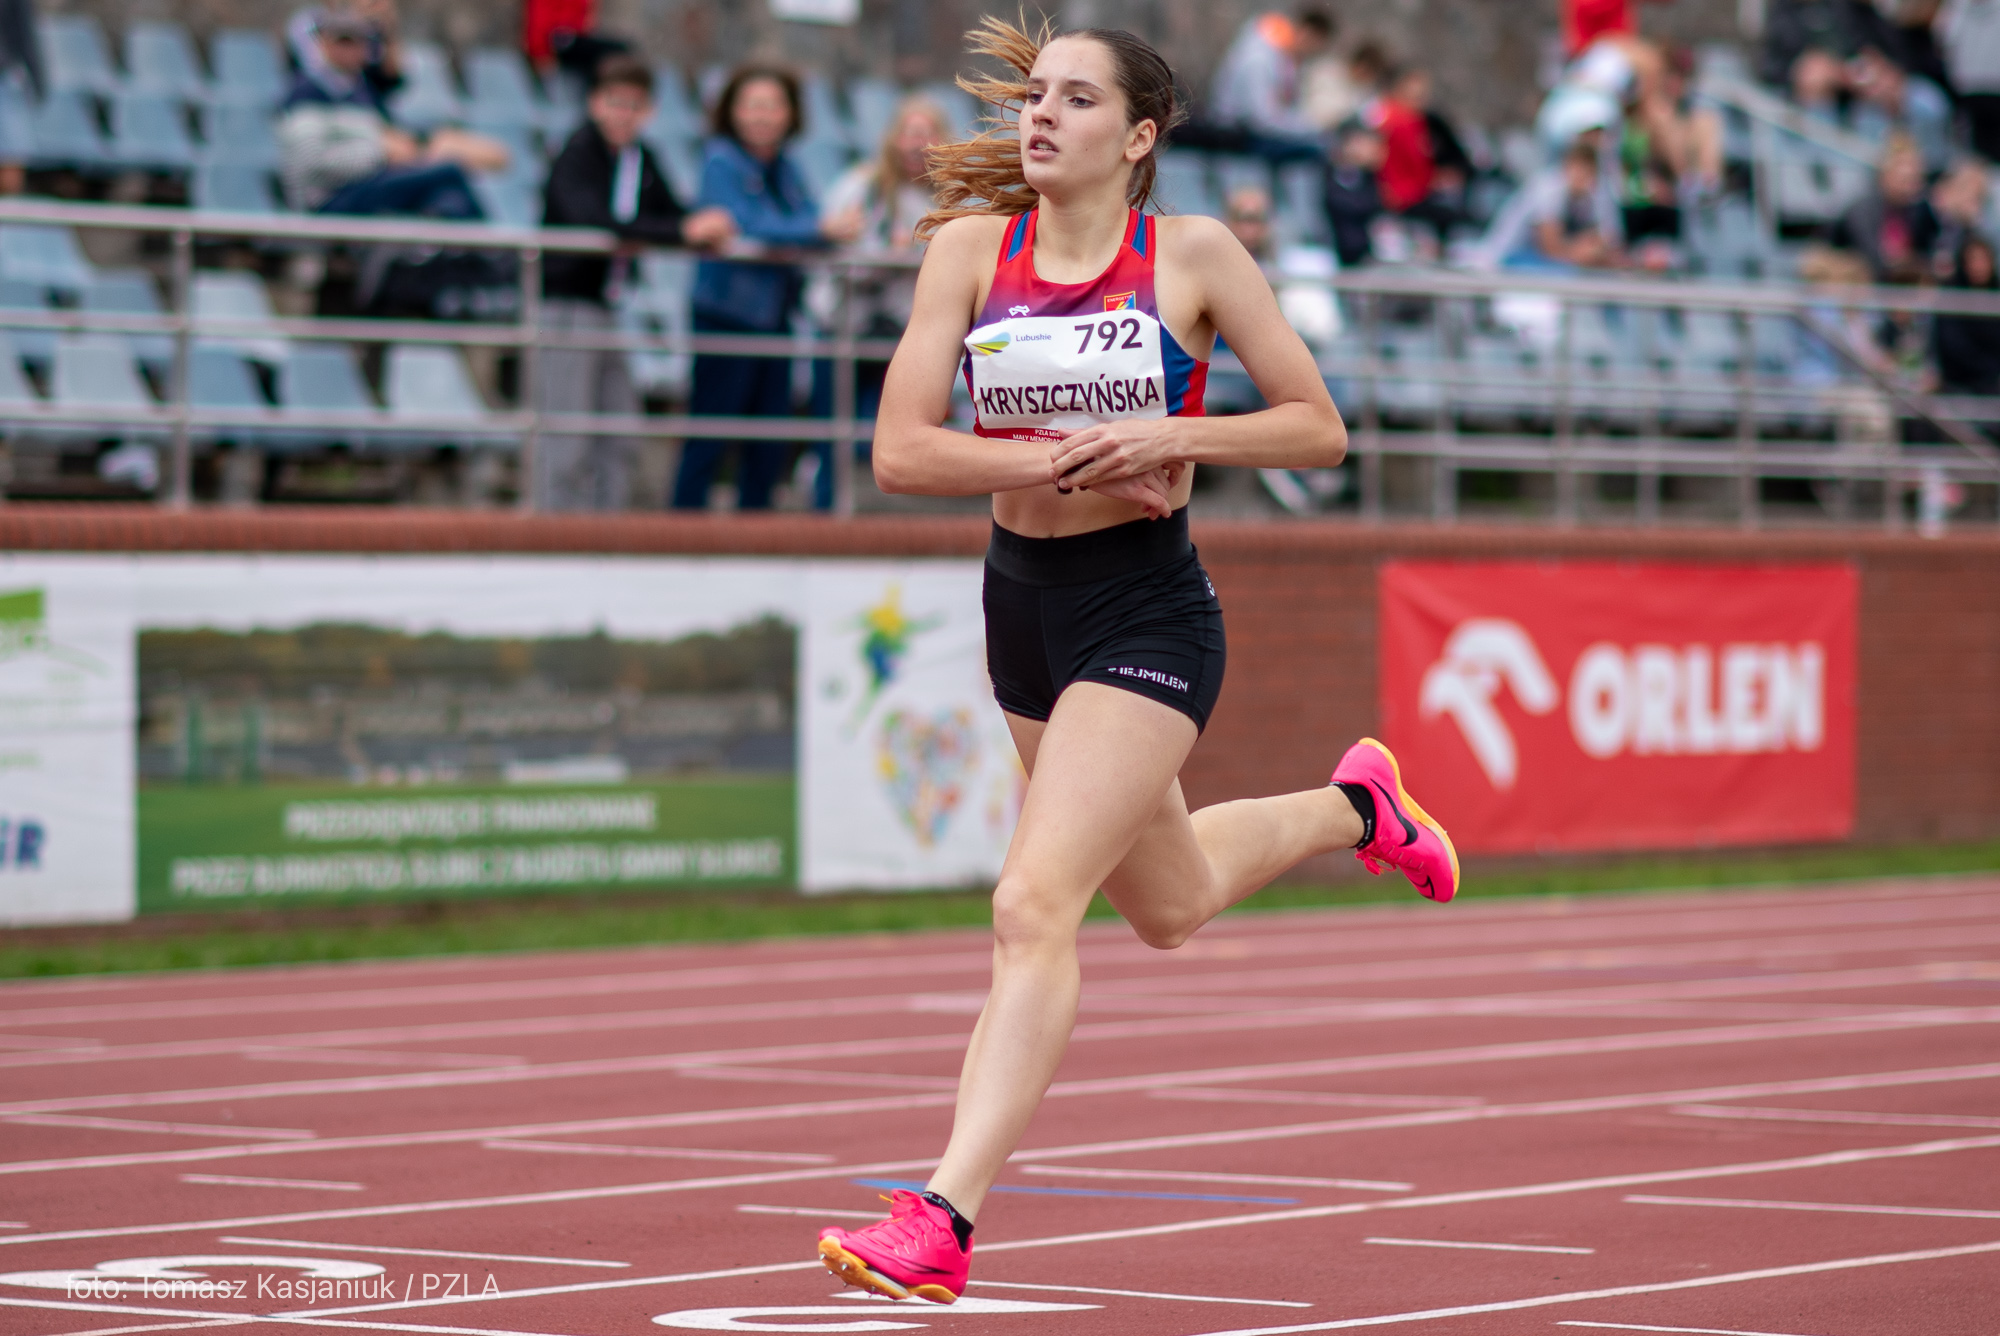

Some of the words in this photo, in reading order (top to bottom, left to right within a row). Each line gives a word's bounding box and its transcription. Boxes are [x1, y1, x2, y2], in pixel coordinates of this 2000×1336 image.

[1015, 333, 1052, 342] Lubuskie
[1074, 318, 1143, 354] 792
[979, 374, 1160, 415] KRYSZCZYŃSKA
[1567, 641, 1825, 758] ORLEN
